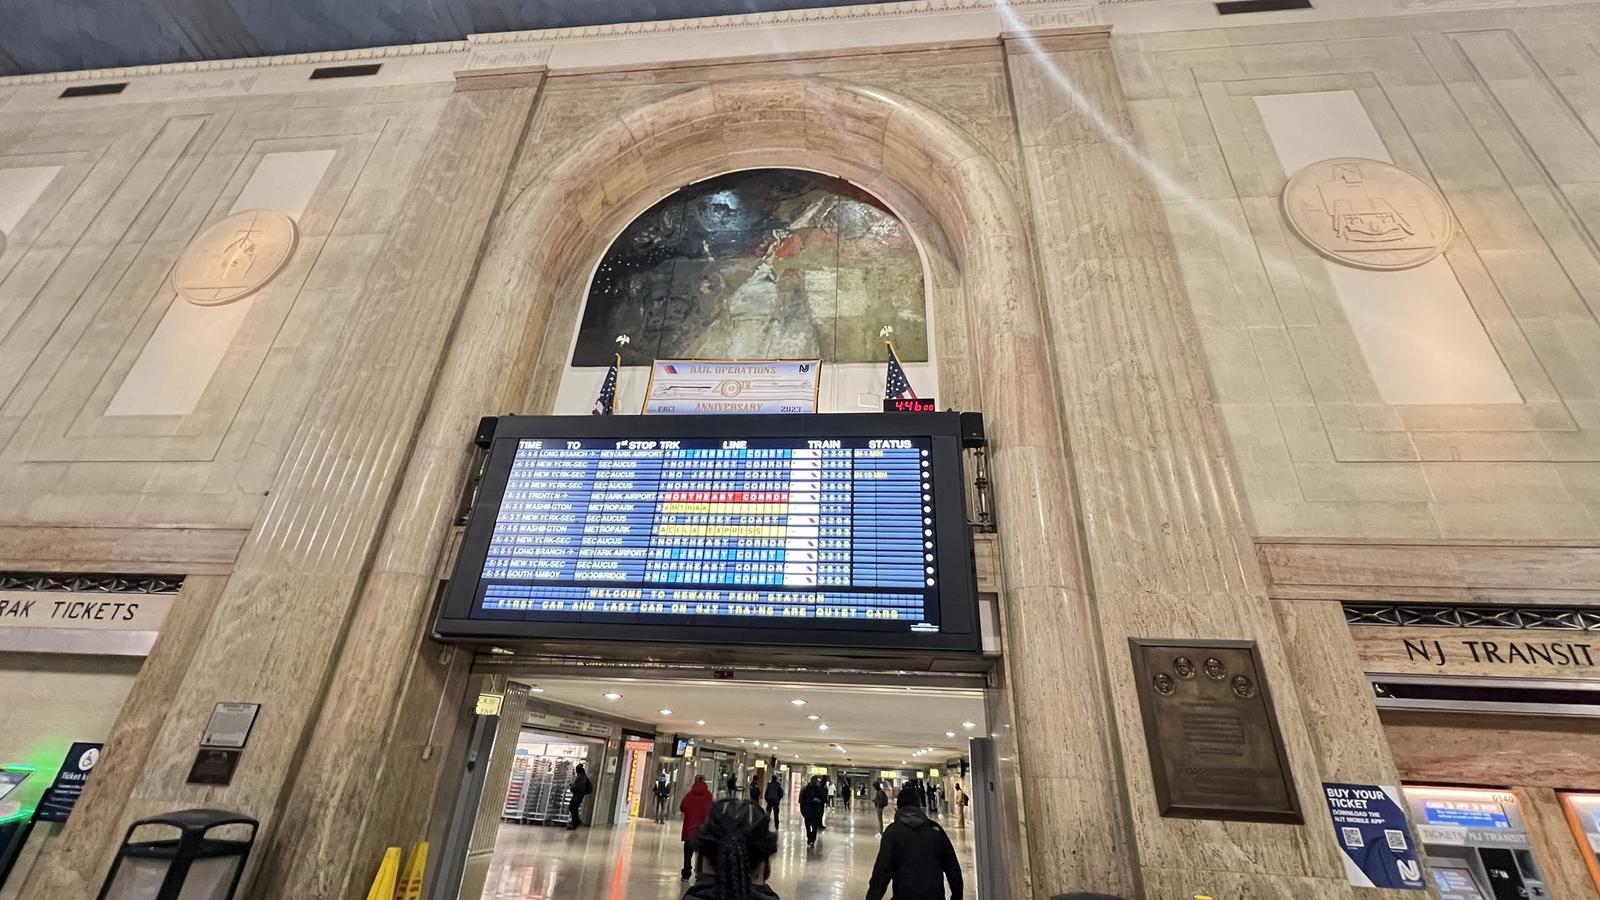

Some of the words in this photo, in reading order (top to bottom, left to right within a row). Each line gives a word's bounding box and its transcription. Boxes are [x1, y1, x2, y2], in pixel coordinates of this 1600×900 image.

[715, 366, 776, 374] OPERATIONS
[695, 402, 763, 412] ANNIVERSARY
[520, 441, 543, 449] TIME
[567, 441, 581, 449] TO
[616, 440, 629, 449] 1st
[629, 441, 657, 449] STOP
[660, 441, 680, 449] TRK
[723, 441, 747, 449] LINE
[808, 440, 840, 448] TRAIN
[869, 440, 912, 448] STATUS
[708, 527, 762, 535] EXPRESS
[613, 549, 647, 557] AIRPORT
[680, 551, 727, 559] JERSEY
[736, 551, 777, 559] COAST
[654, 562, 727, 571] NORTHEAST
[652, 573, 668, 581] NO
[677, 573, 725, 582] JERSEY
[734, 574, 775, 583] COAST
[590, 589, 643, 599] WELCOME
[651, 590, 665, 600] TO
[673, 591, 721, 601] NEWARK
[729, 592, 759, 602] PENN
[767, 593, 825, 603] STATION
[51, 601, 139, 621] TICKETS
[498, 600, 534, 609] FIRST
[542, 601, 564, 610] CAR
[571, 602, 595, 611] AND
[603, 603, 633, 612] LAST
[640, 603, 664, 613] CAR
[671, 604, 688, 613] ON
[695, 604, 719, 614] NJT
[727, 605, 775, 615] TRAINS
[782, 607, 807, 616] ARE
[816, 607, 857, 617] QUIET
[866, 609, 899, 619] CARS
[1403, 639, 1446, 666] NJ
[1462, 641, 1595, 667] TRANSIT
[61, 771, 82, 780] Ticket
[1326, 788, 1349, 798] BUY
[1352, 789, 1385, 800] YOUR
[1329, 798, 1368, 809] TICKET
[1333, 809, 1368, 817] DOWNLOAD
[1422, 829, 1465, 841] TICKETS
[1468, 832, 1484, 841] NJ
[1486, 832, 1528, 844] TRANSIT
